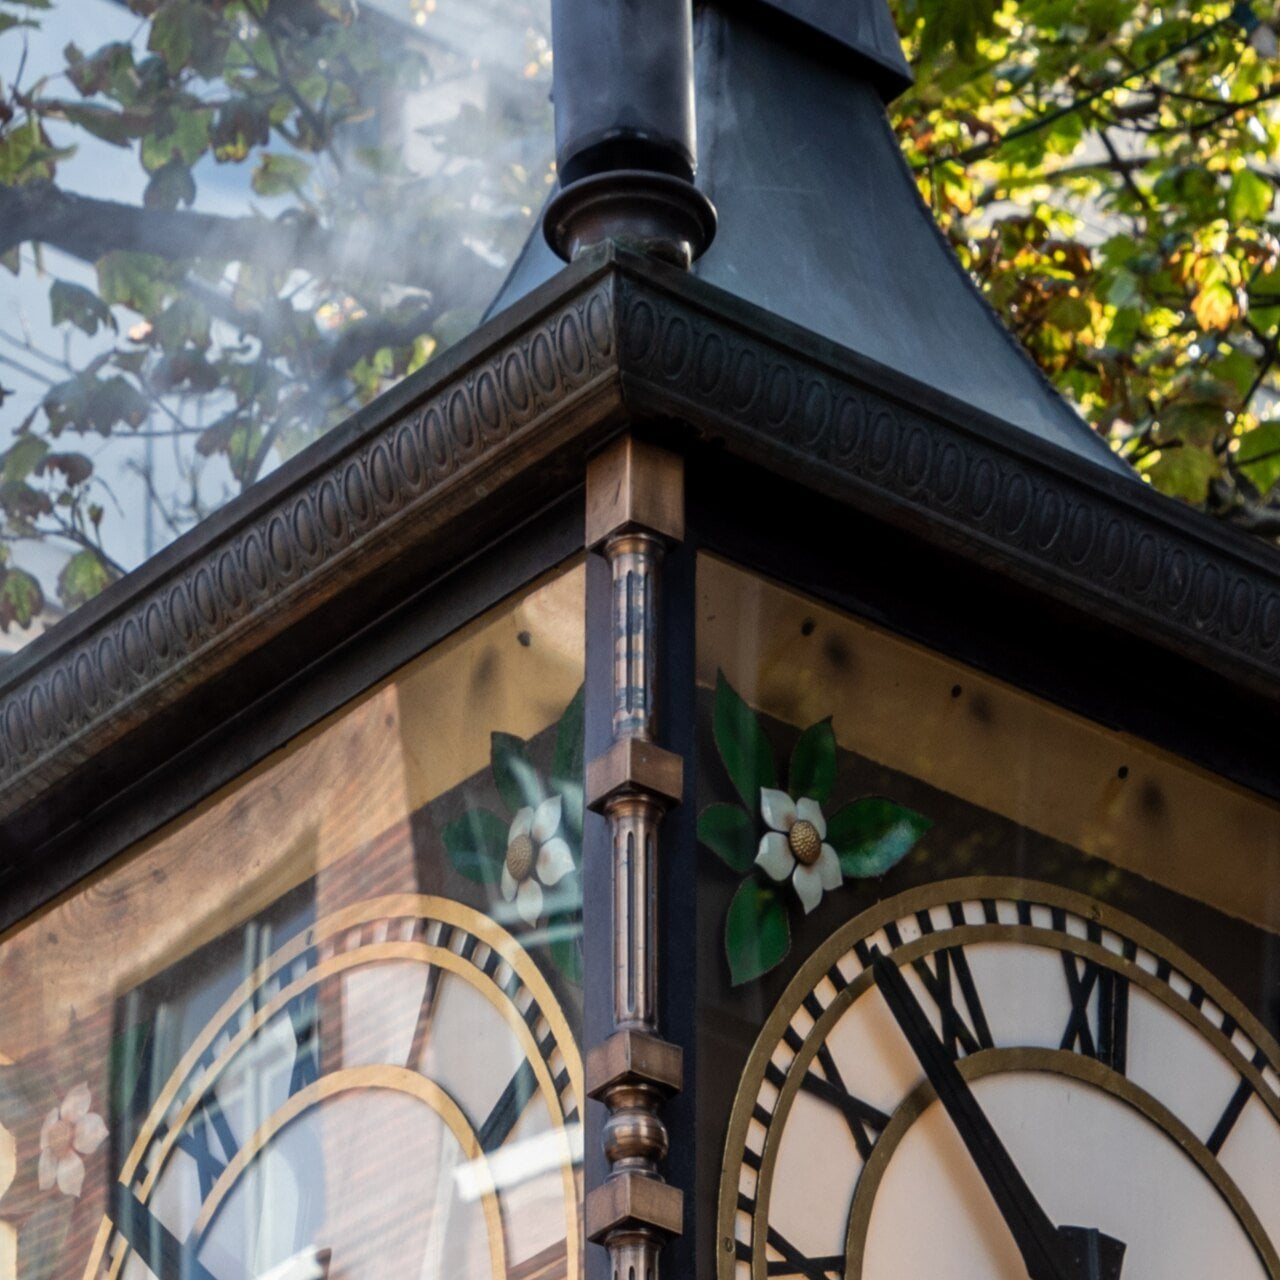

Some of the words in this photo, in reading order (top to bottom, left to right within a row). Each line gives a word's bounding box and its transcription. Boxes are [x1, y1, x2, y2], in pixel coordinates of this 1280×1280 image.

[1061, 951, 1129, 1078] XII
[176, 1090, 239, 1205] XI
[801, 1040, 892, 1163] X
[1206, 1077, 1254, 1157] I
